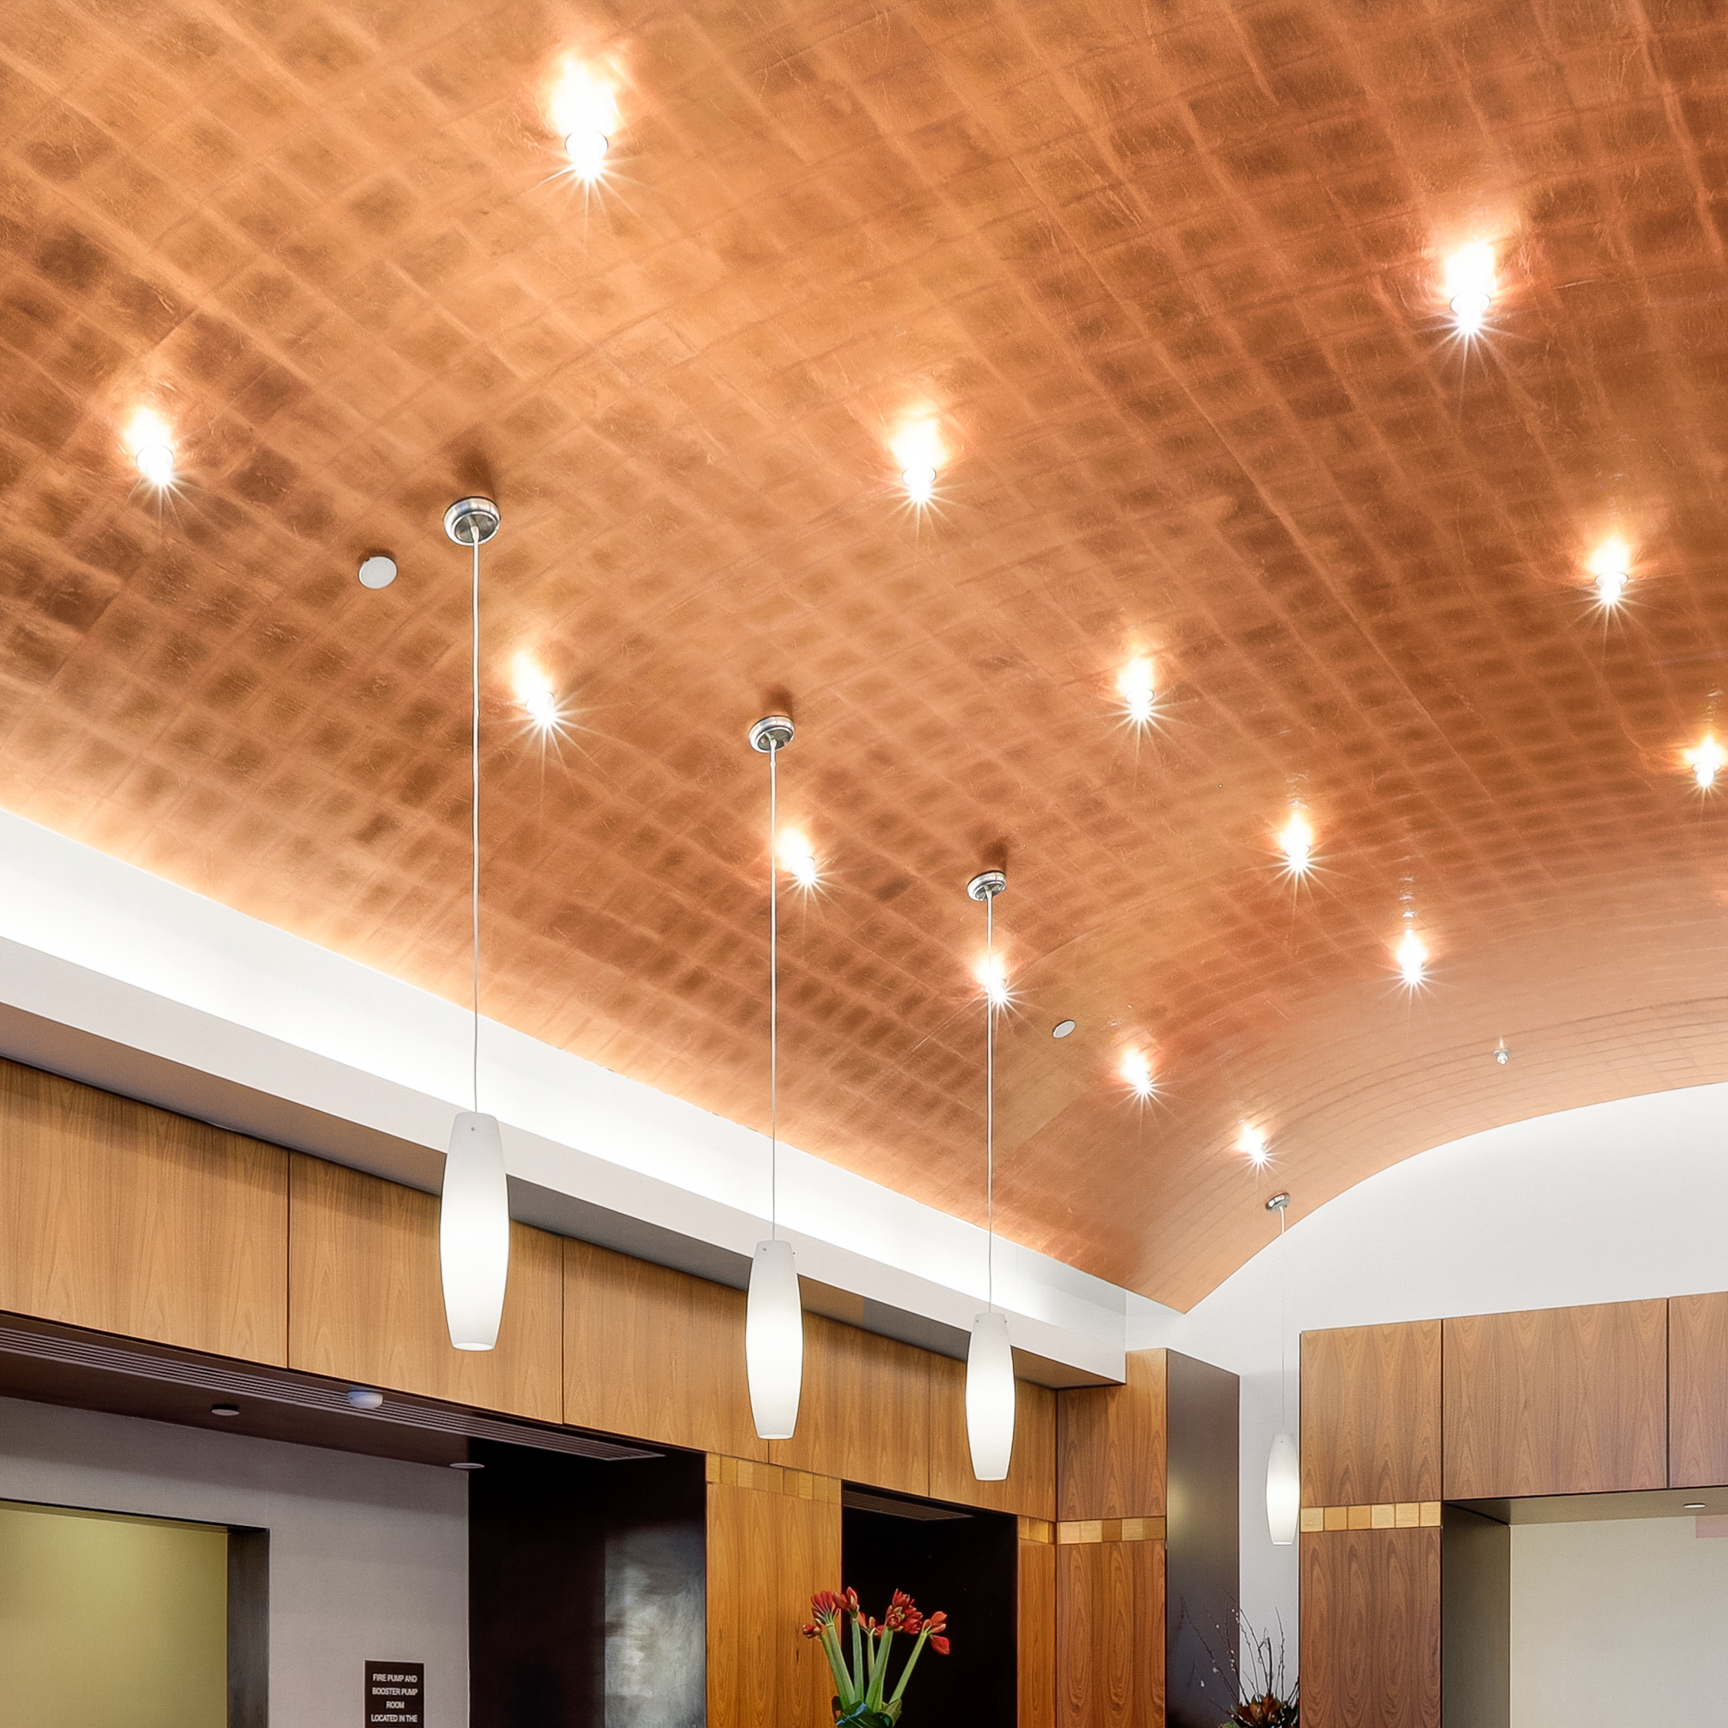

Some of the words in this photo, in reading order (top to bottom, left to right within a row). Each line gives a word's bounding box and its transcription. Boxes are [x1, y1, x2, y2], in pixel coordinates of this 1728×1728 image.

[372, 1673, 387, 1682] FIRE
[387, 1674, 404, 1682] PUMP
[404, 1675, 418, 1683] AND
[372, 1687, 401, 1695] BOOSTER
[401, 1688, 418, 1696] PUMP
[385, 1701, 405, 1709] ROOM
[370, 1714, 398, 1722] LOCATED
[406, 1714, 418, 1723] THE
